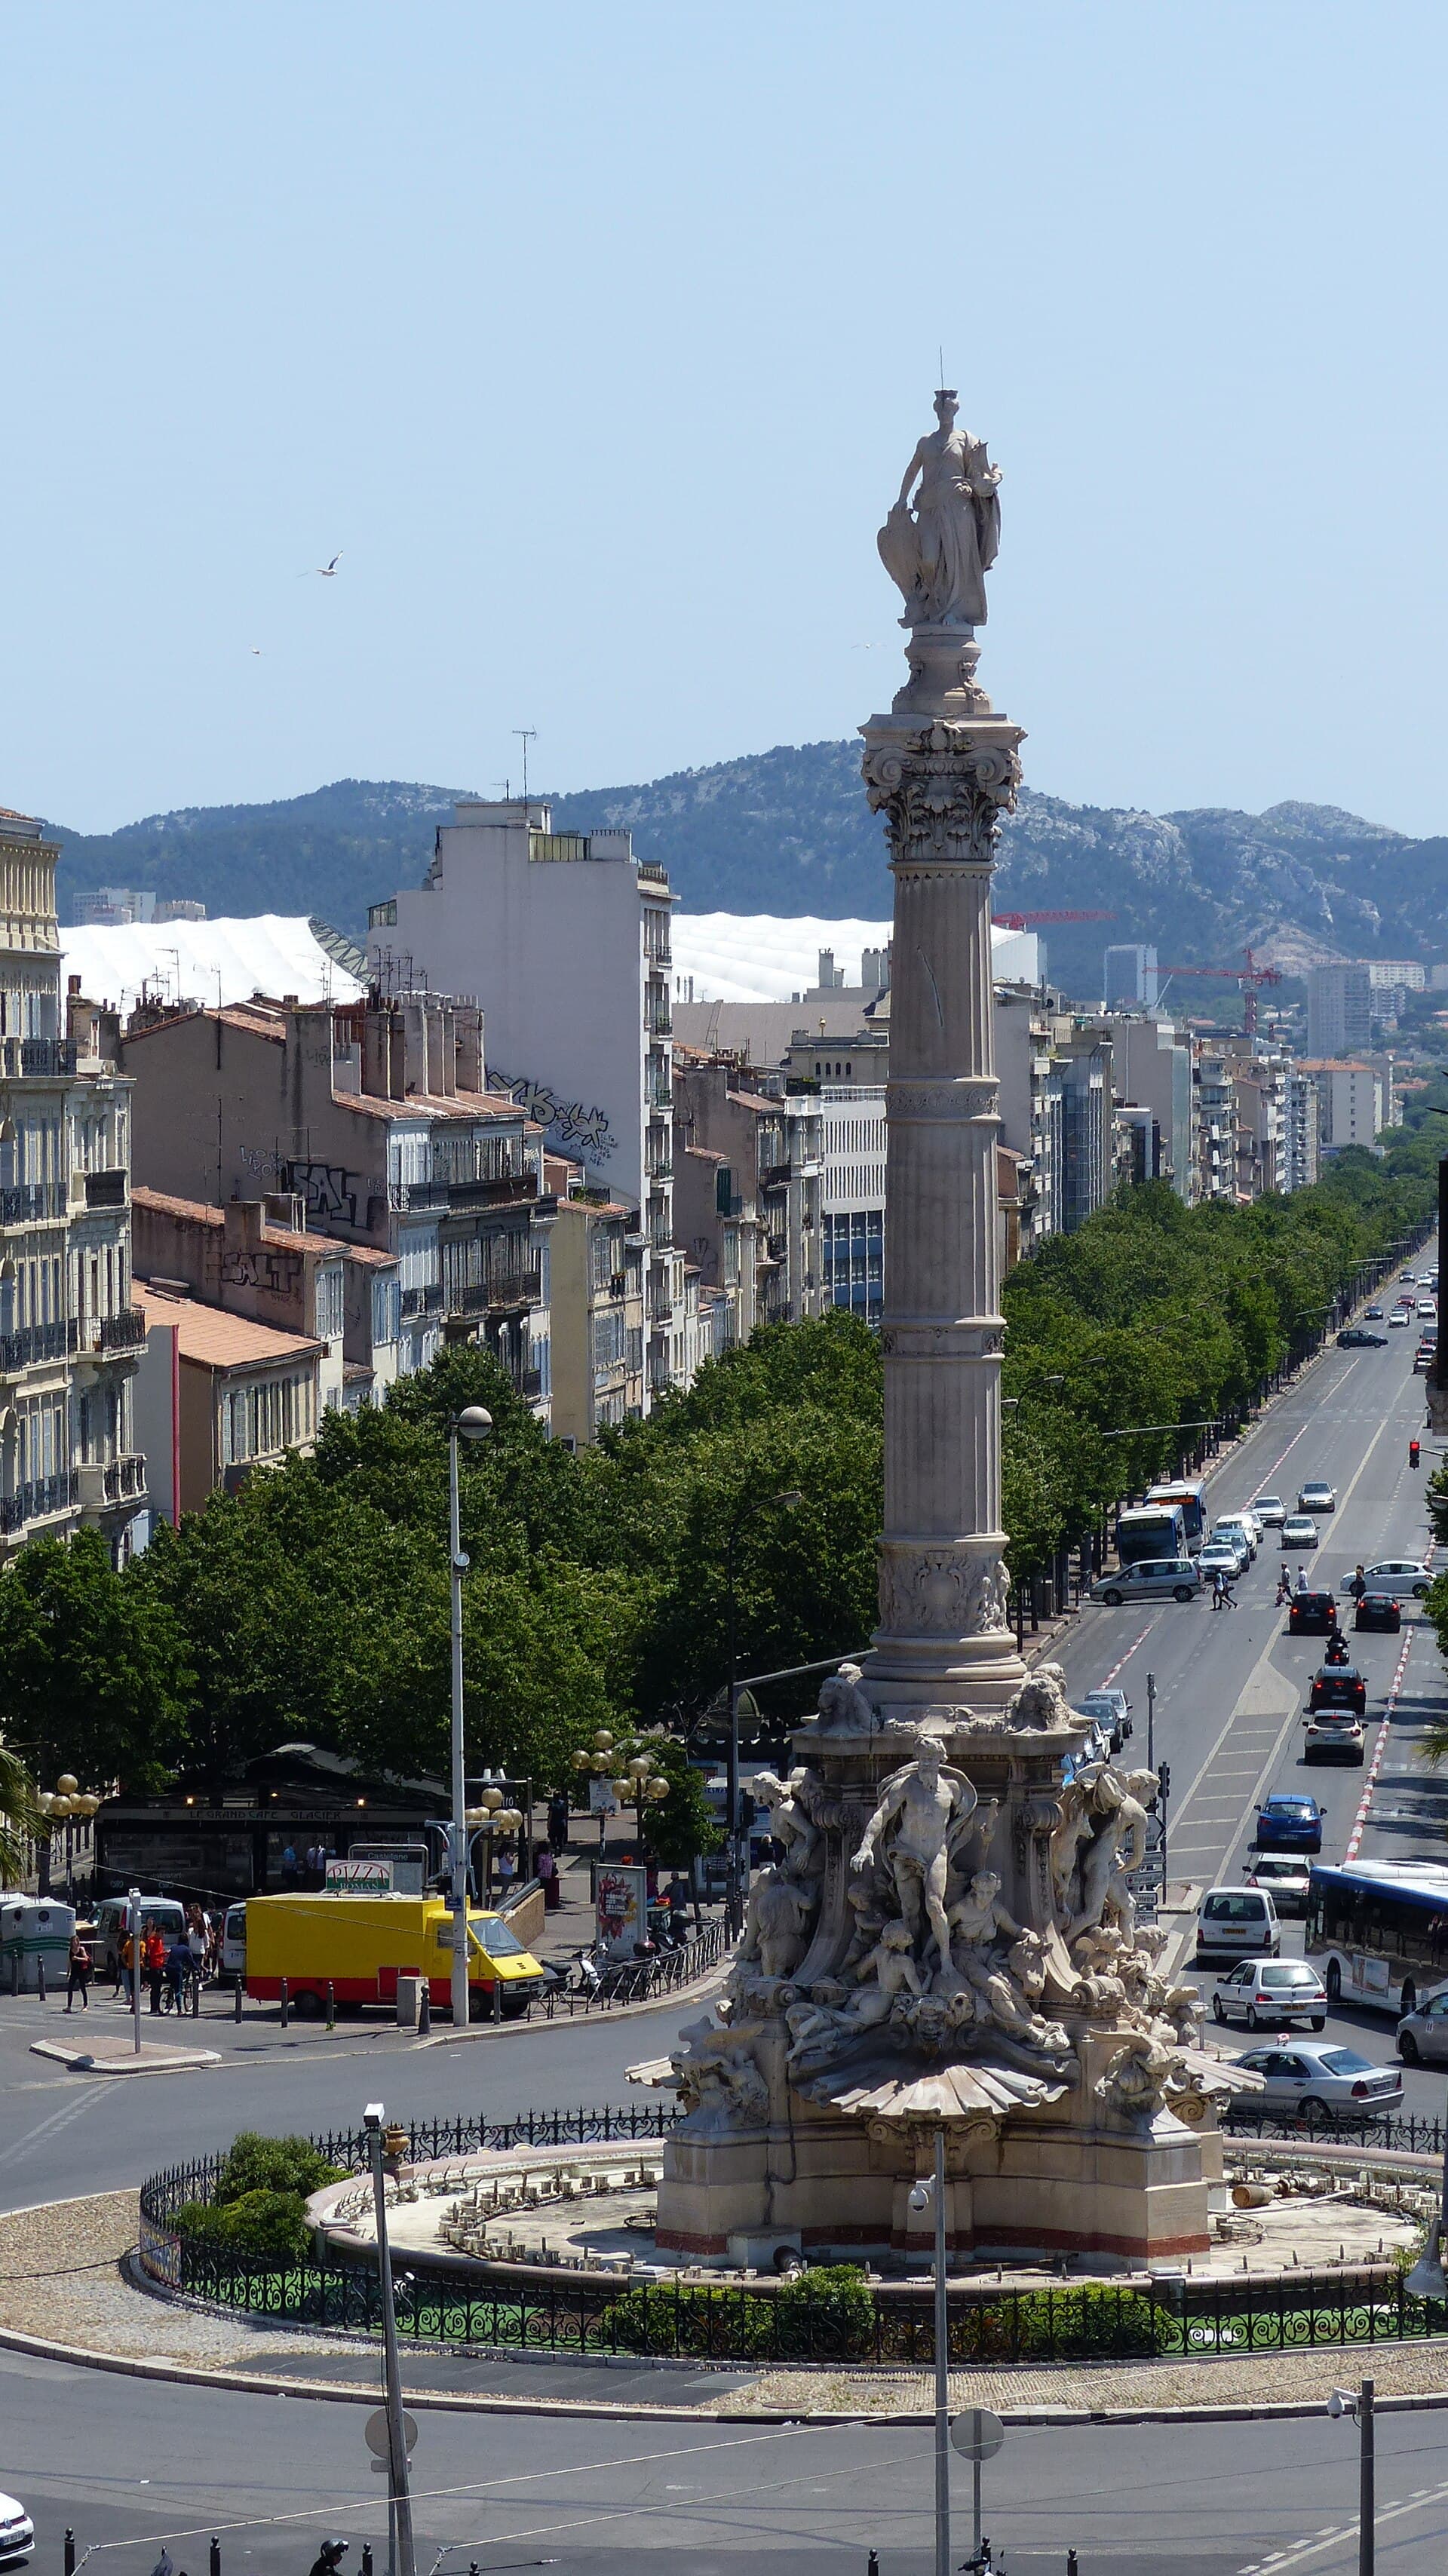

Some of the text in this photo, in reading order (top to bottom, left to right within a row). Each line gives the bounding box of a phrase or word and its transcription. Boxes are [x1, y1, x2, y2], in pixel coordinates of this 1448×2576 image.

[222, 1252, 303, 1293] SALT
[190, 1811, 201, 1819] LE
[206, 1811, 246, 1819] GRAND
[290, 1811, 340, 1820] GLACIER
[332, 1864, 386, 1885] PIZZA
